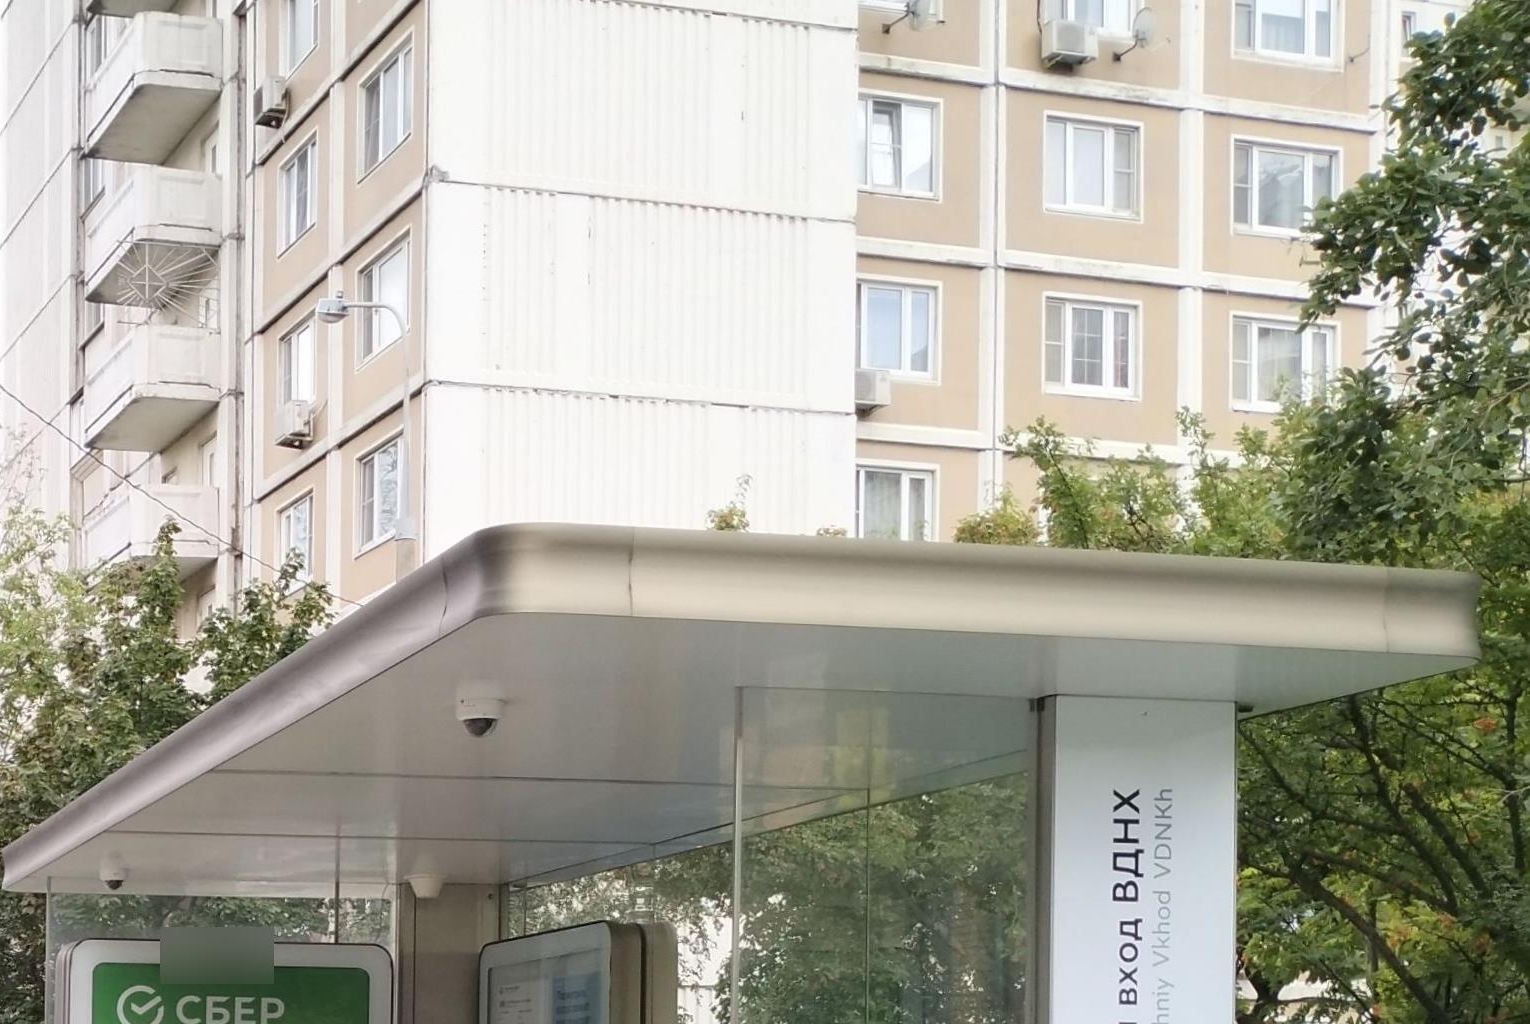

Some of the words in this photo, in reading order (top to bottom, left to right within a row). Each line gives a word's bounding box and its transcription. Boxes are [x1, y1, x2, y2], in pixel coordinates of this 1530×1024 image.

[1112, 789, 1145, 903] ВДНХ
[1153, 788, 1173, 879] VDNKh
[1118, 918, 1143, 1006] вход
[1151, 890, 1171, 967] Vkhod
